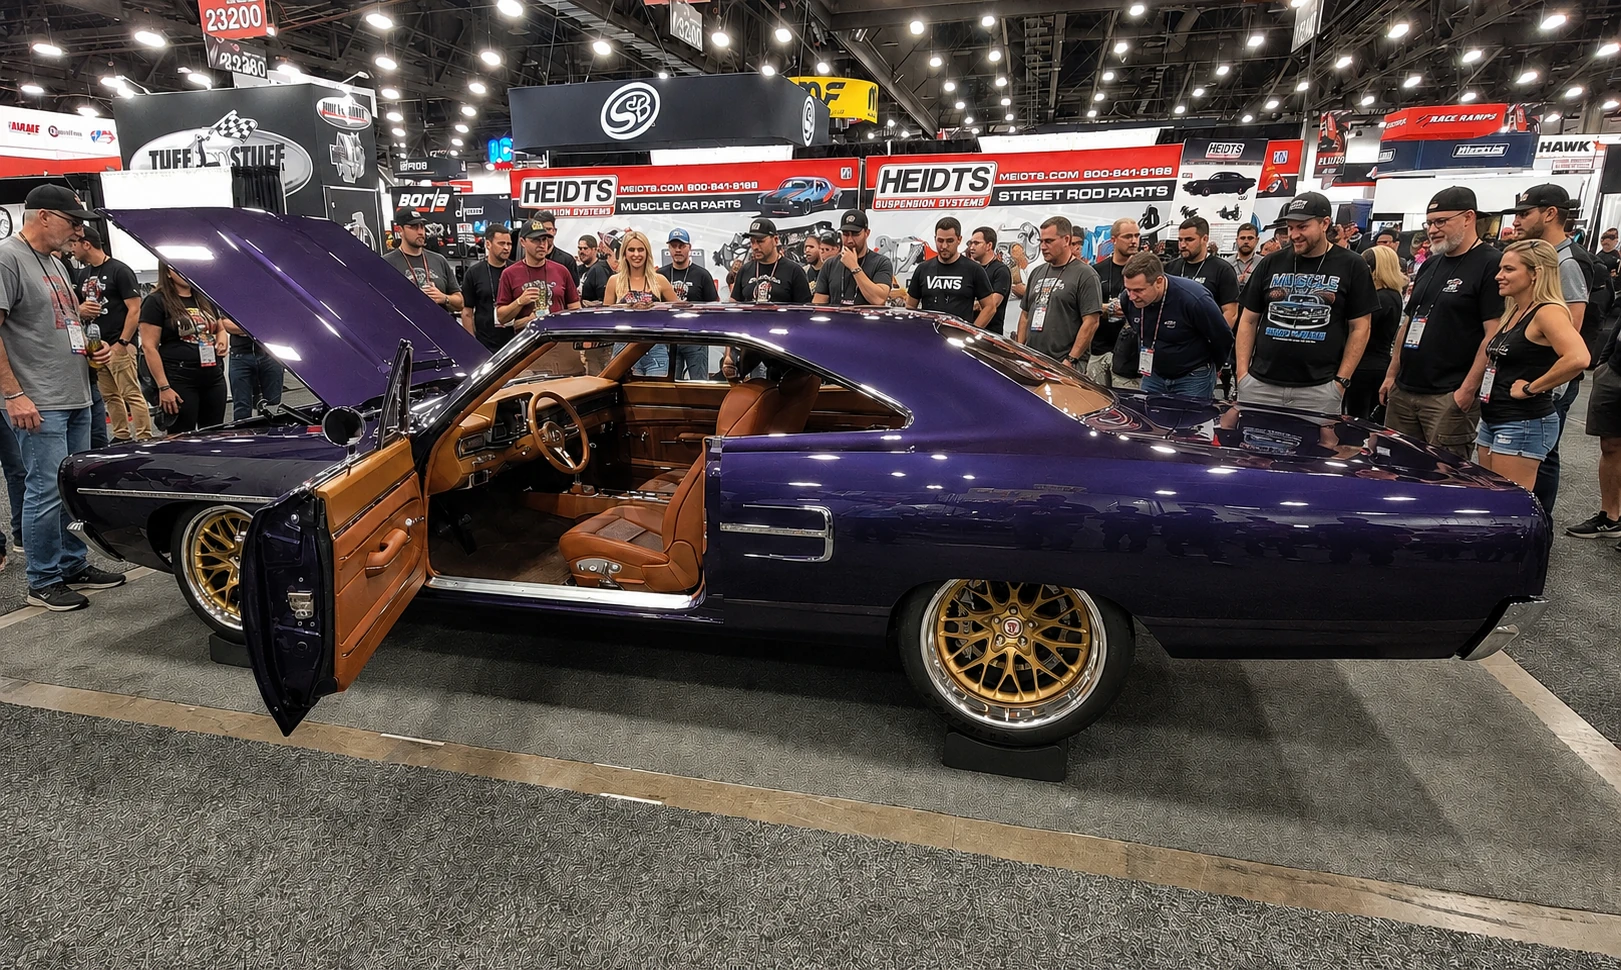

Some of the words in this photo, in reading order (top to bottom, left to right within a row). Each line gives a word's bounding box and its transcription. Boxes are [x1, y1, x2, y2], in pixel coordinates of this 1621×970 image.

[205, 4, 262, 31] 23200
[1429, 114, 1458, 123] RACE
[1209, 142, 1243, 154] HEIDTS
[1539, 141, 1591, 153] HAWK
[149, 149, 191, 170] TUFF
[880, 166, 991, 194] HEIDTS
[523, 179, 613, 203] HEIDTS
[998, 189, 1064, 201] STREET
[1067, 188, 1105, 200] ROD
[1108, 186, 1169, 198] PARTS
[620, 202, 670, 212] MUSCLE
[672, 201, 699, 210] CAR
[701, 200, 741, 209] PARTS
[927, 275, 963, 290] VANS
[1269, 273, 1340, 292] MUSCLE
